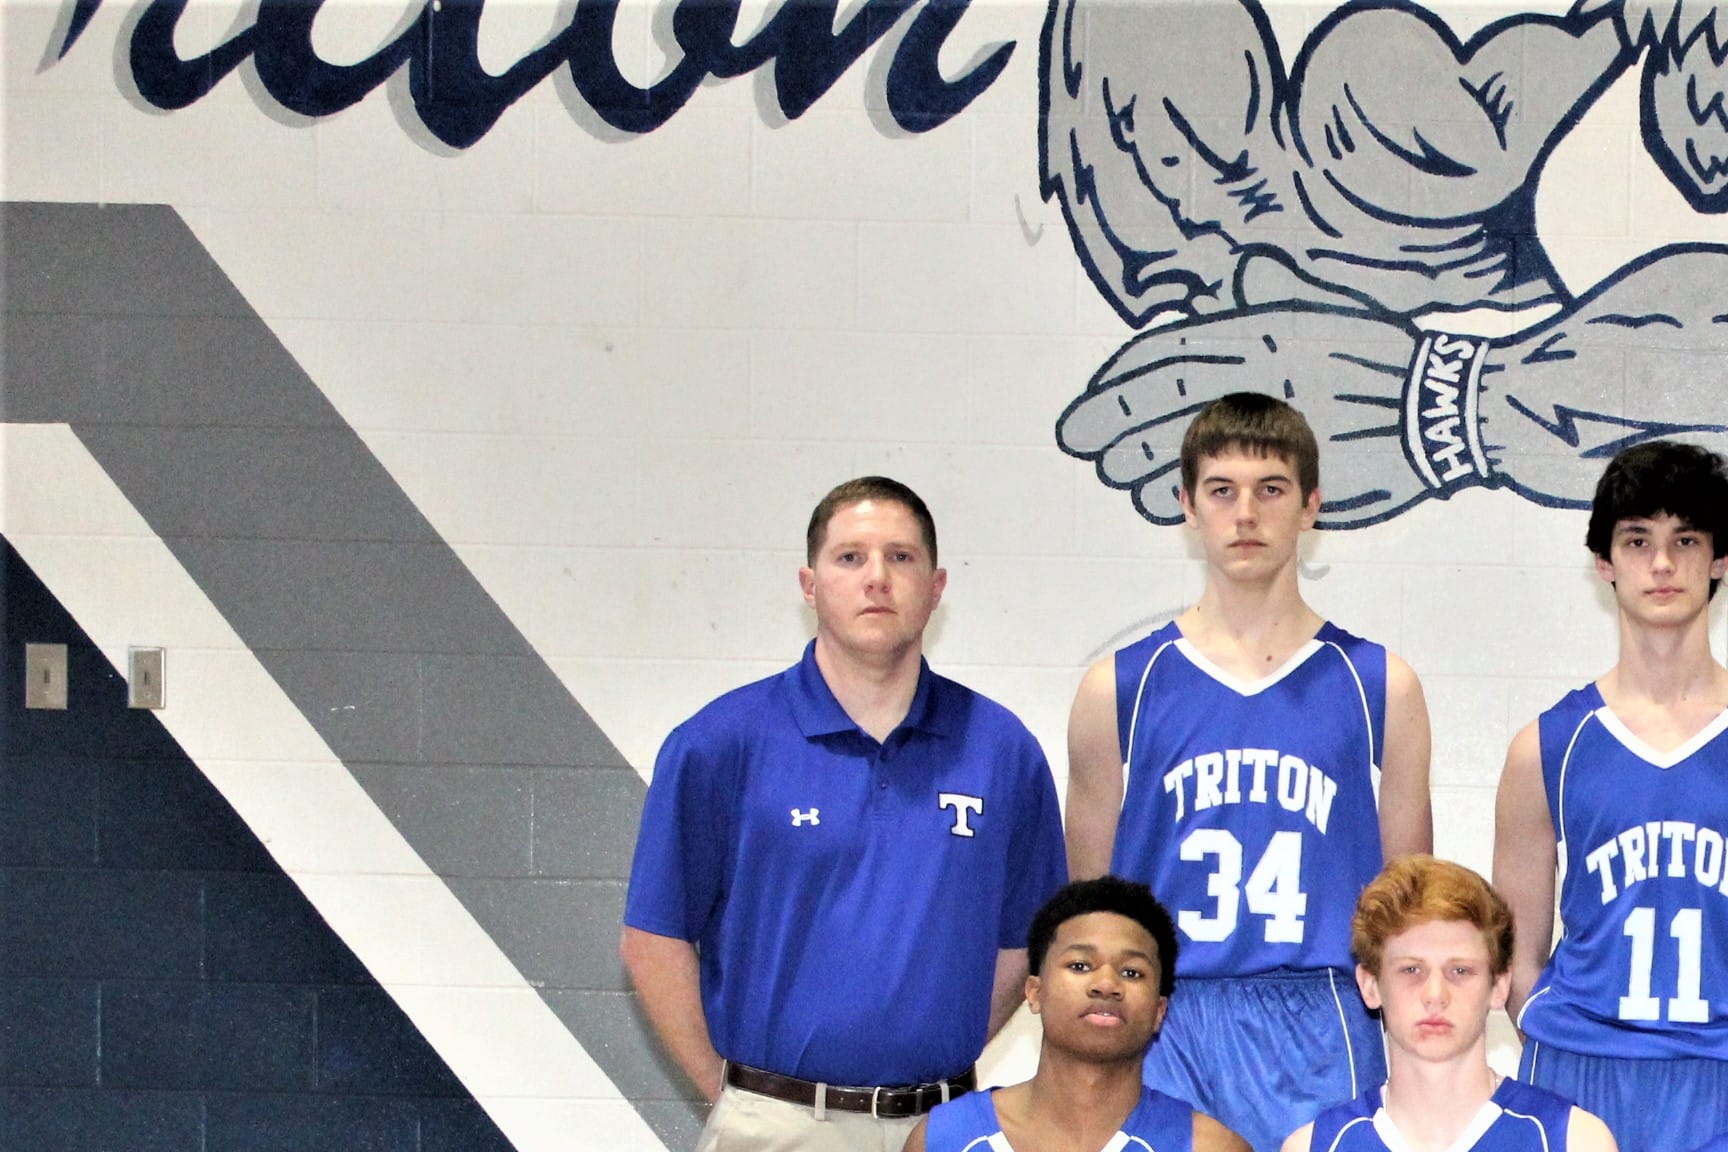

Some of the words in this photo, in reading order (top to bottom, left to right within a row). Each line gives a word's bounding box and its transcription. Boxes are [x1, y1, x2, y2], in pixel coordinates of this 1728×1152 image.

[1422, 335, 1475, 482] HAWKS
[938, 792, 983, 837] T
[1164, 749, 1336, 838] TRITON
[1178, 829, 1306, 943] 34
[1619, 908, 1708, 1022] 11
